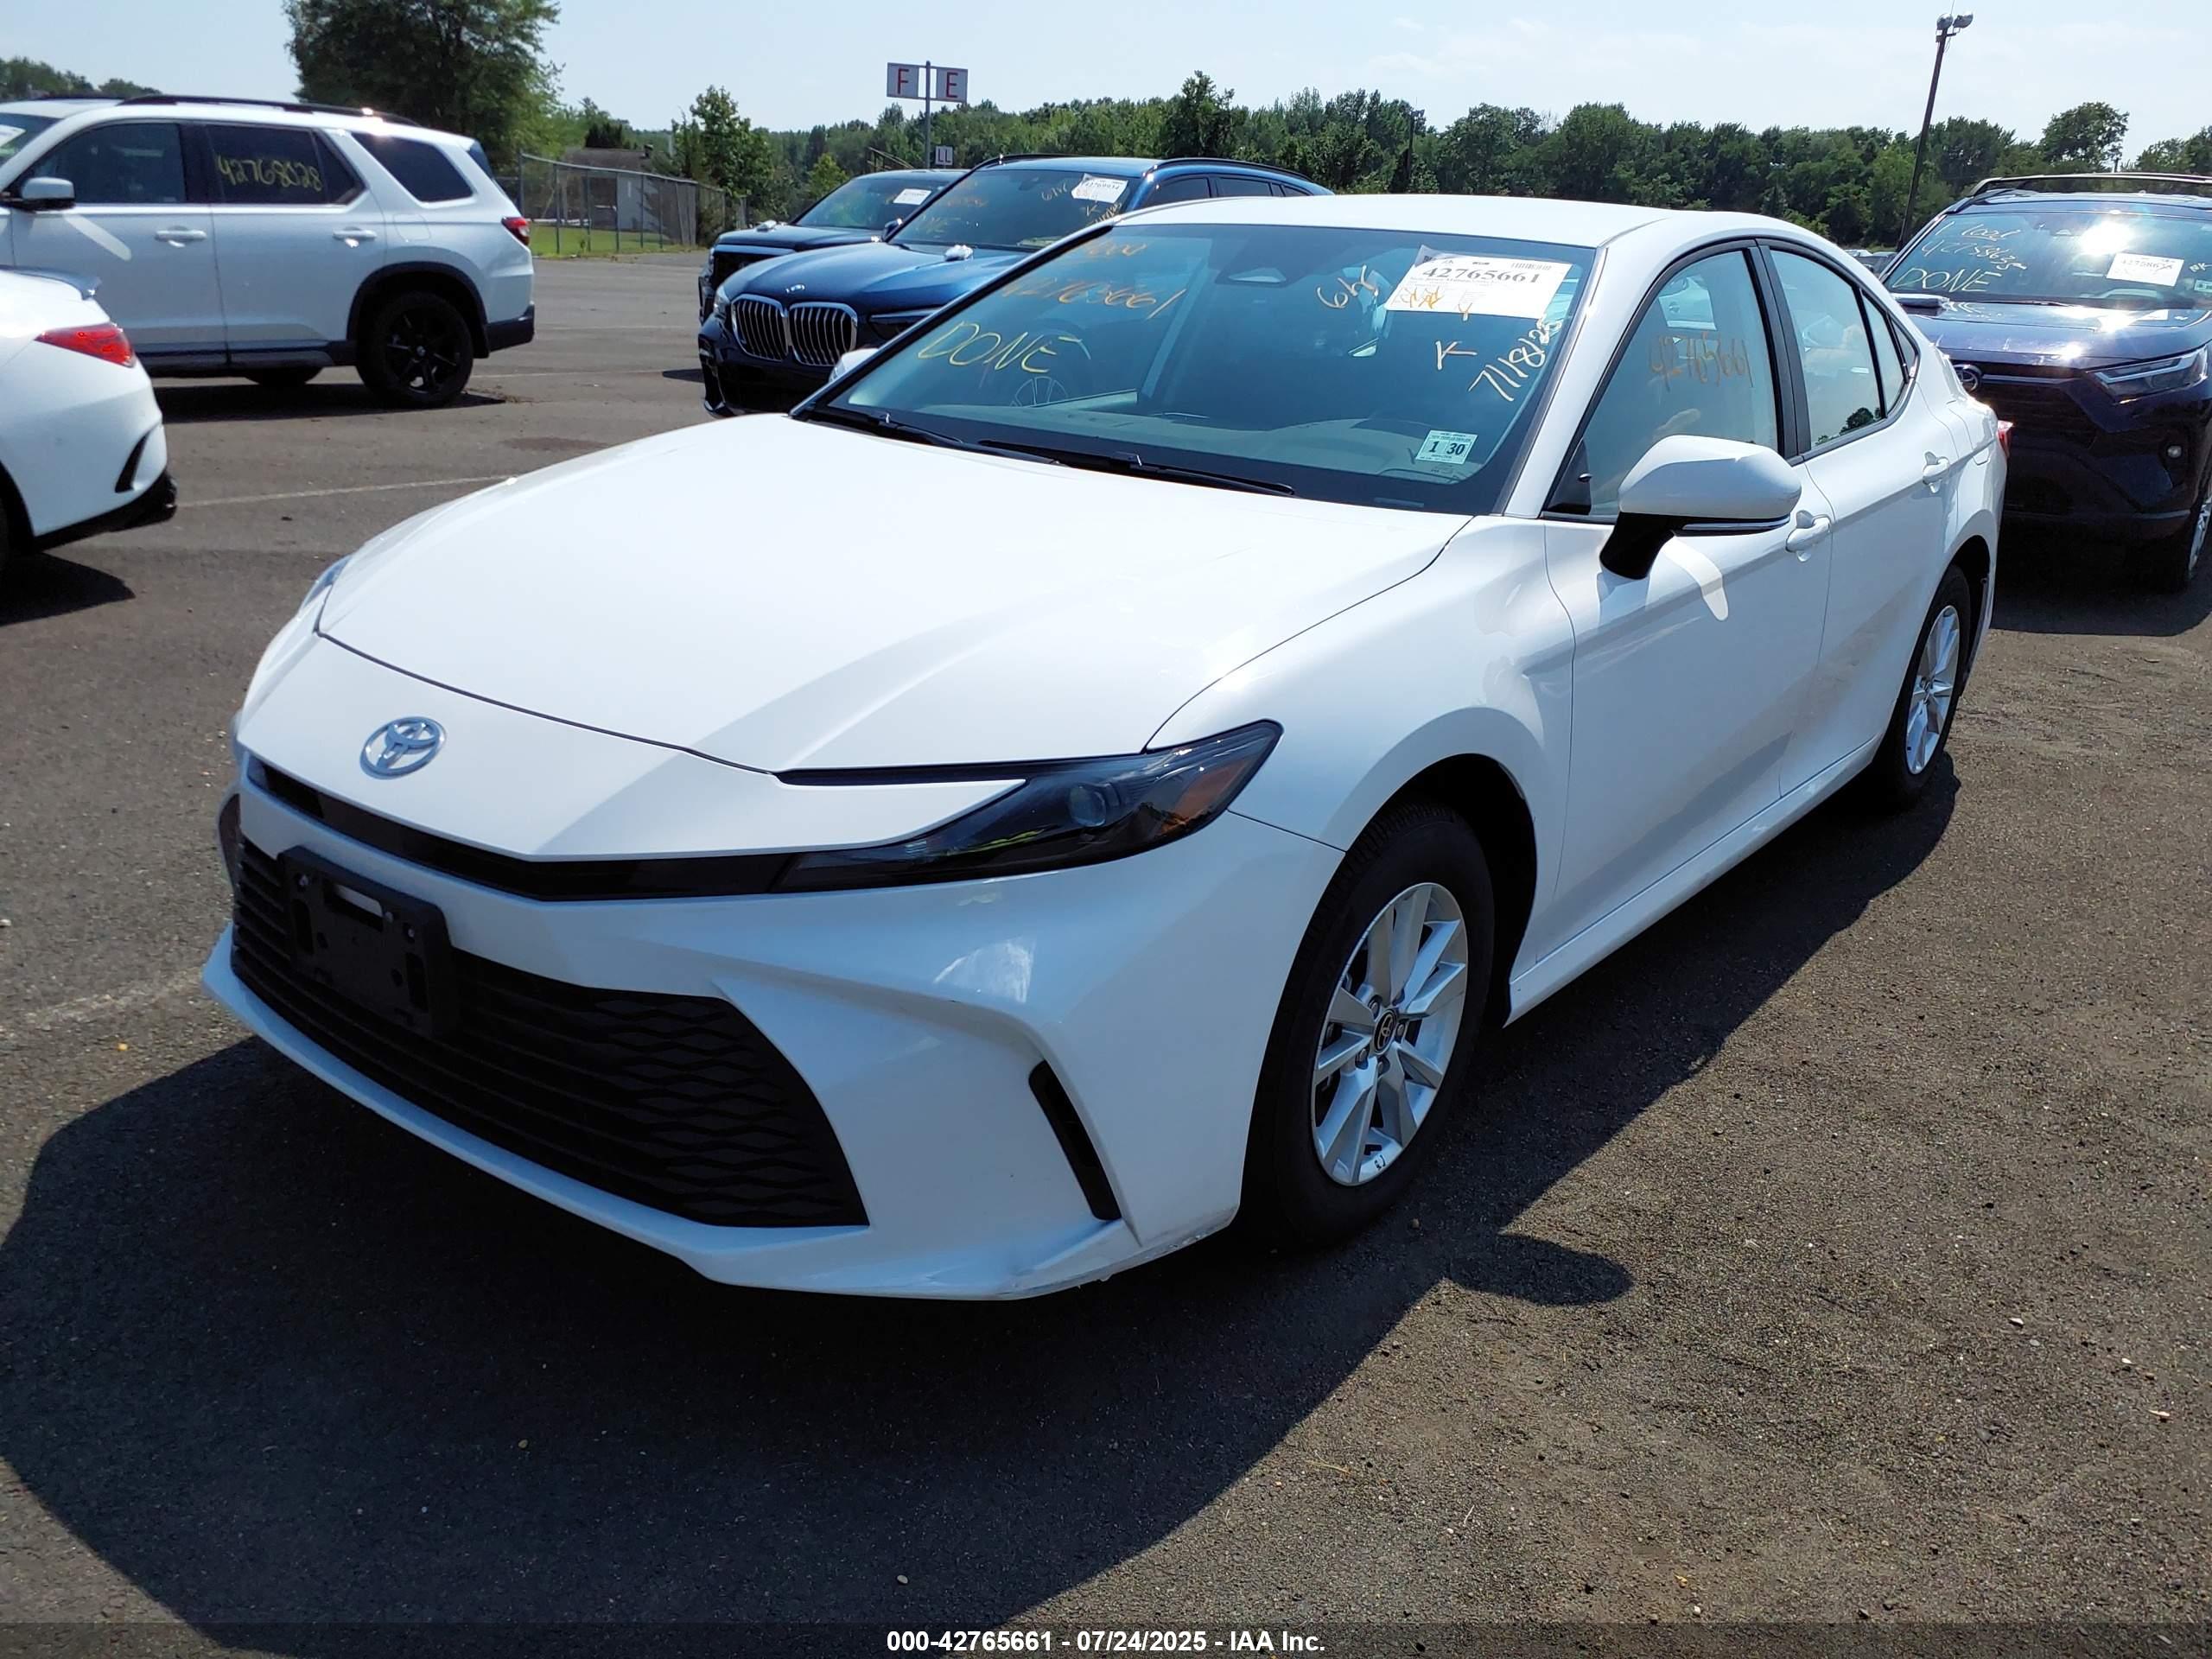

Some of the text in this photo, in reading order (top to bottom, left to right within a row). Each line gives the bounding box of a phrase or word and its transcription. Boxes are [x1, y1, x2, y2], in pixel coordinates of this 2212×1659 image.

[896, 67, 910, 95] F
[945, 71, 959, 99] E
[1421, 267, 1541, 283] 42765661
[1891, 267, 2003, 293] DONE
[918, 321, 1080, 373] DONE
[1434, 340, 1478, 371] K
[1428, 440, 1466, 455] 1 30
